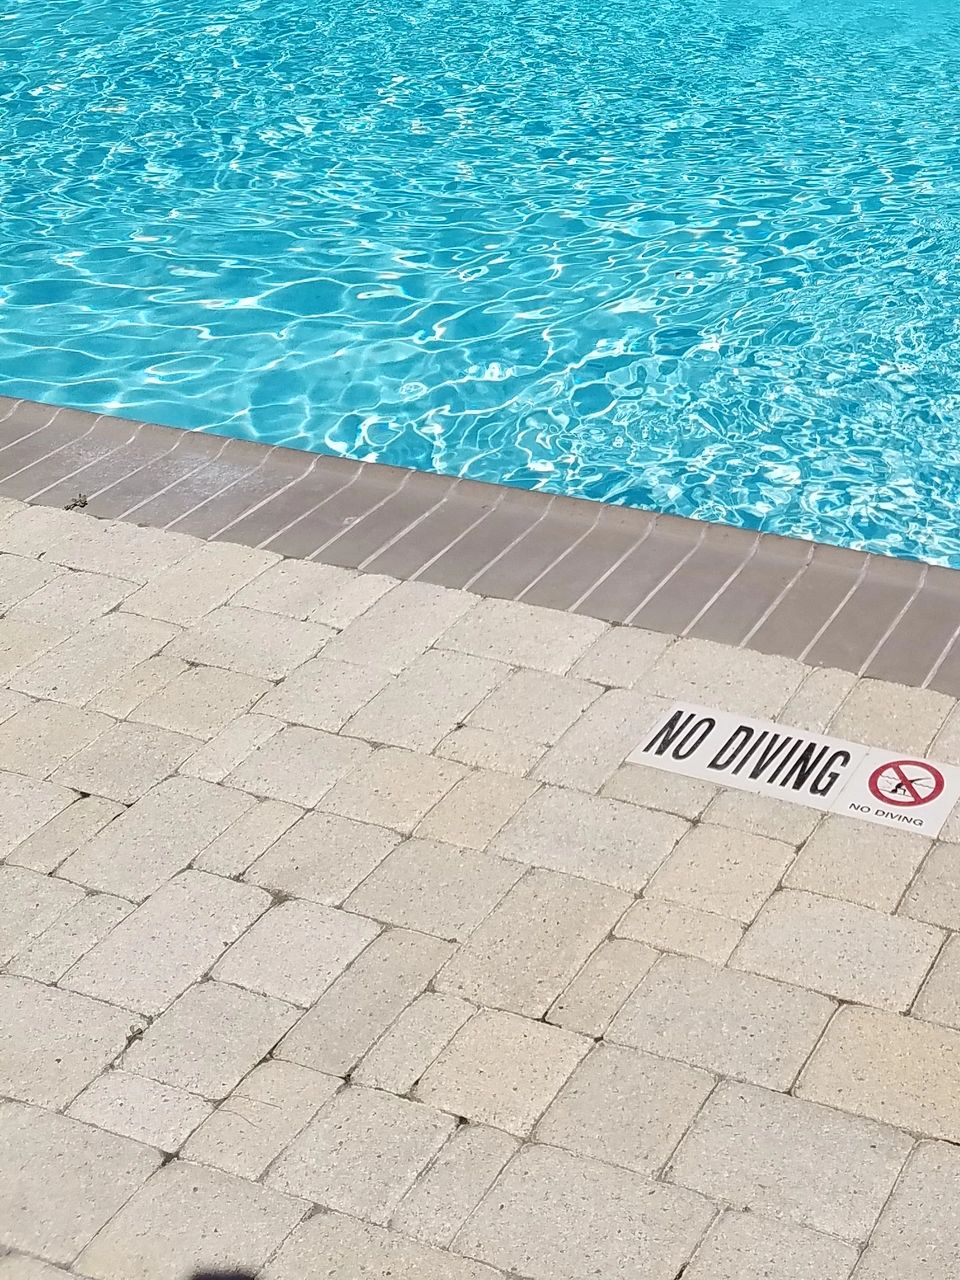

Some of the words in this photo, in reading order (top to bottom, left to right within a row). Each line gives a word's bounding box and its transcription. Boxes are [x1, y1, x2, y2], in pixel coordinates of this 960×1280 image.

[642, 710, 716, 760] NO
[707, 725, 851, 797] DIVING
[848, 803, 871, 813] NO
[874, 809, 924, 827] DIVING
